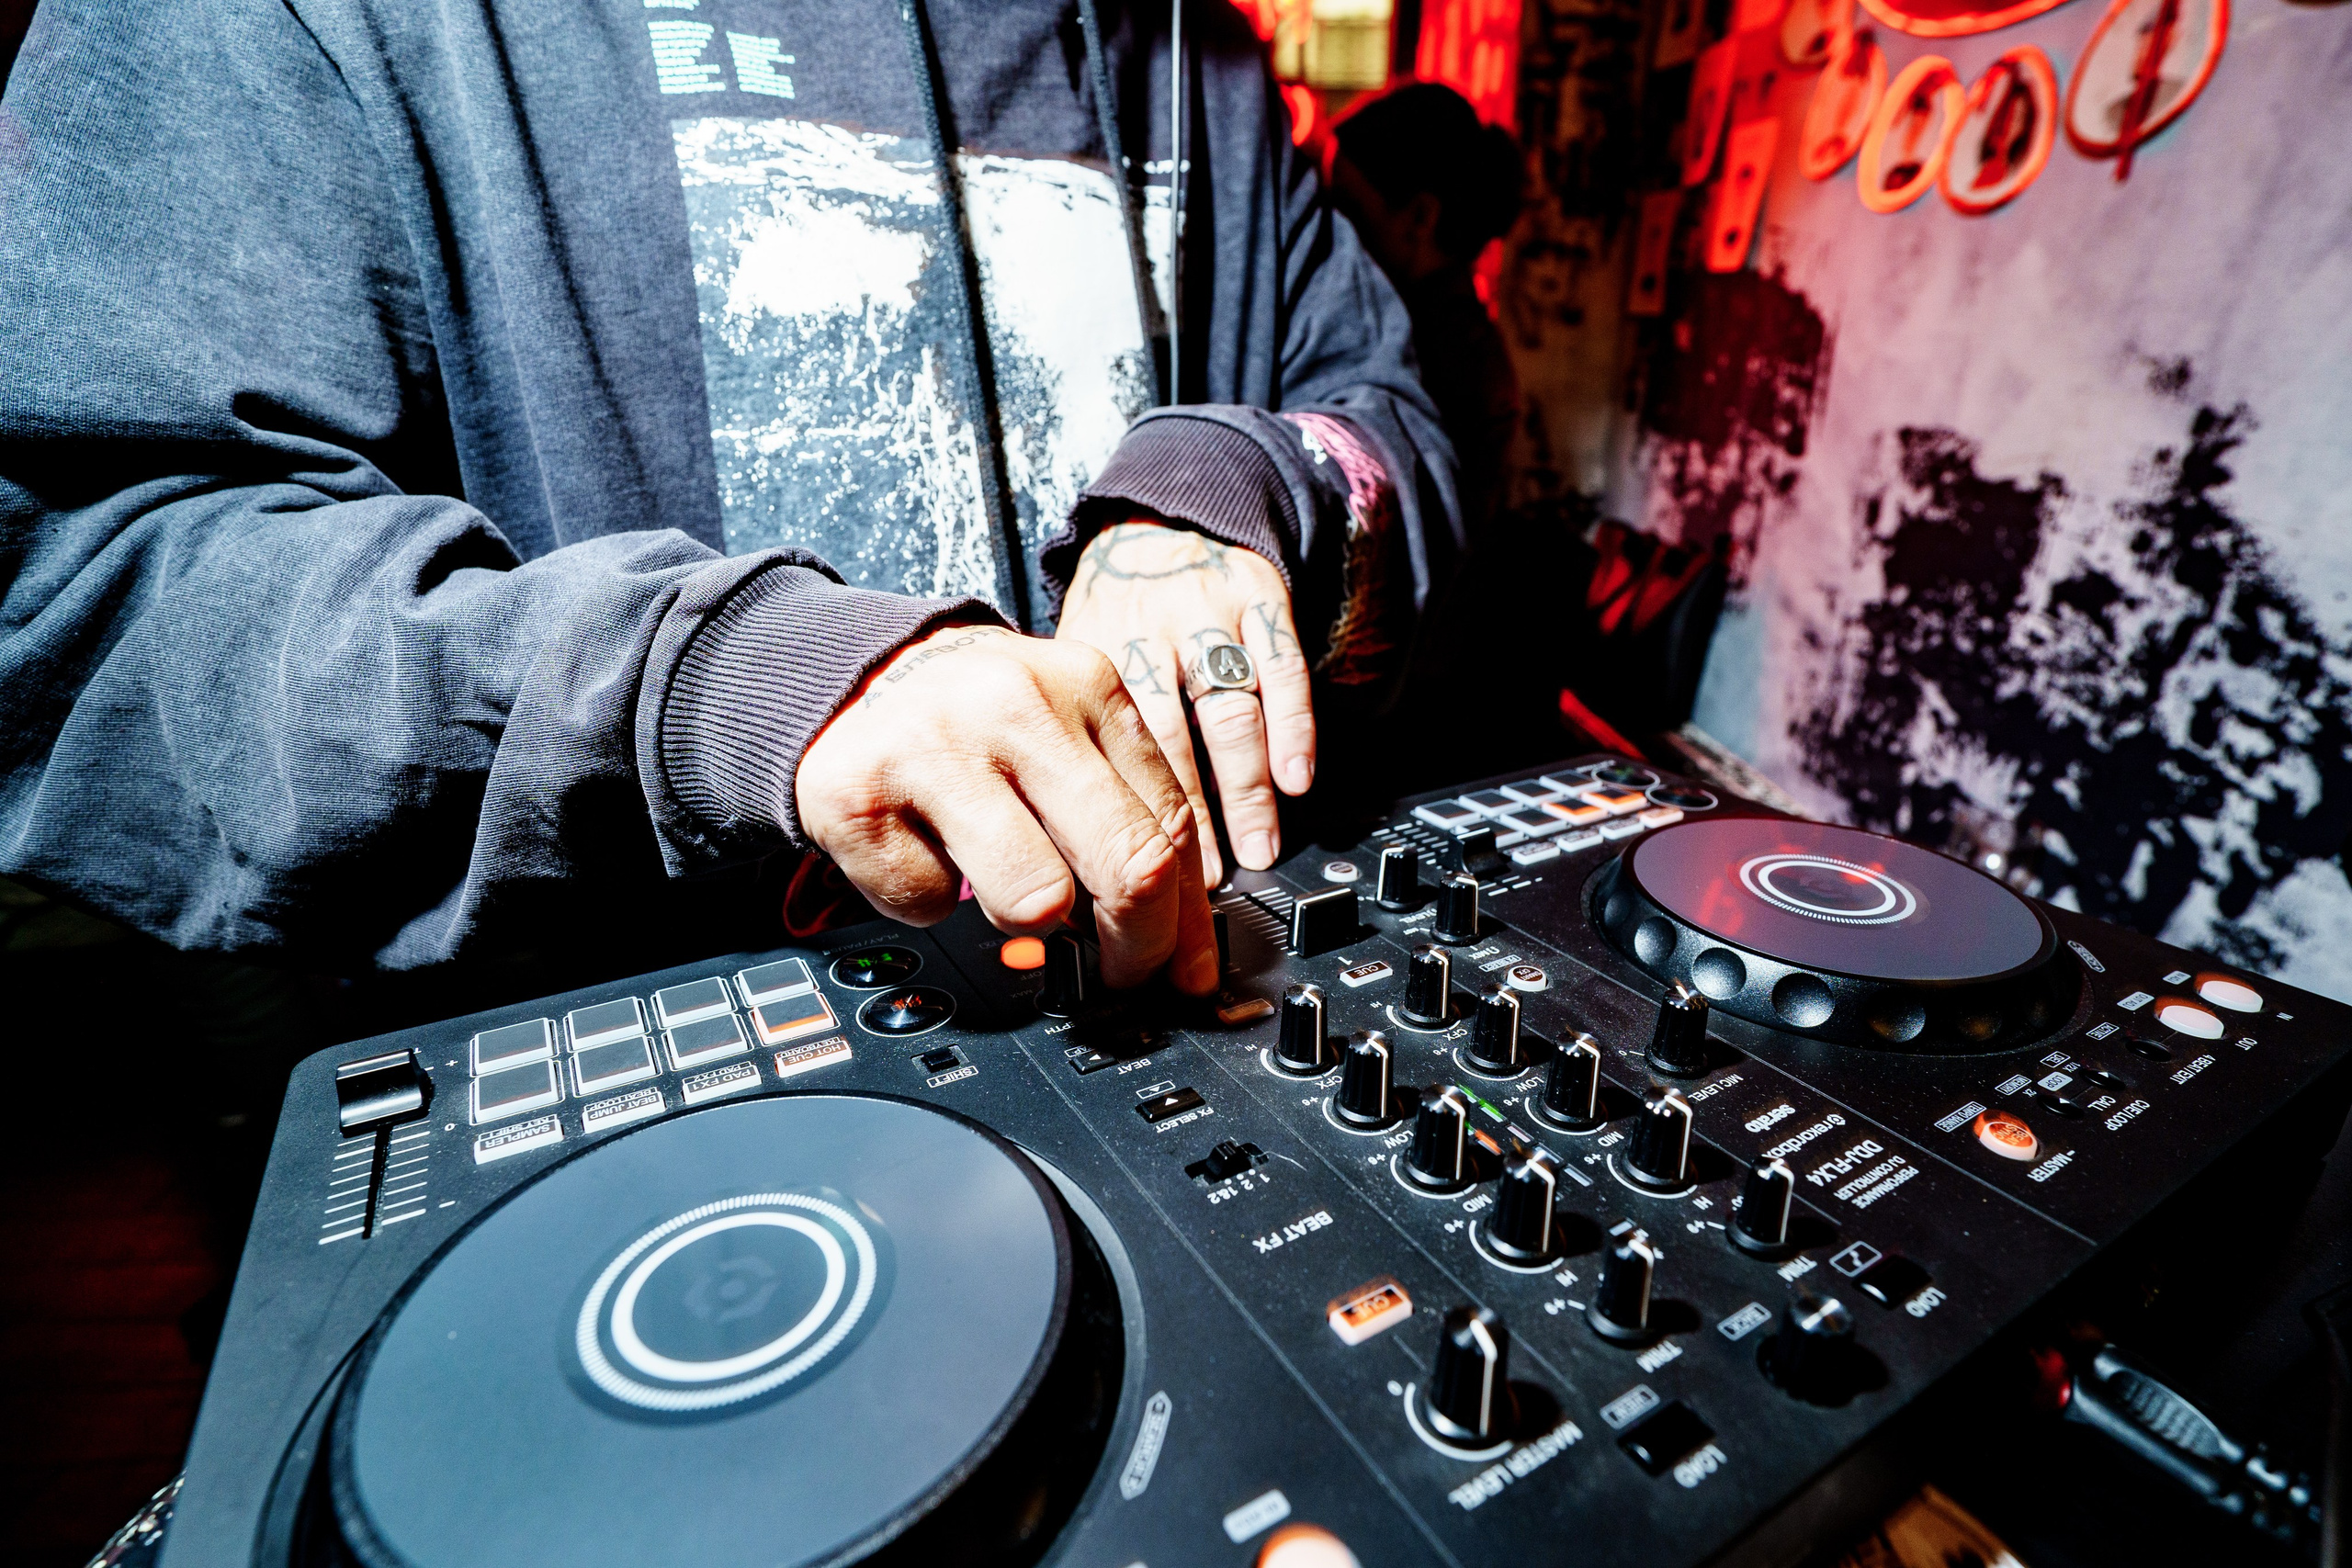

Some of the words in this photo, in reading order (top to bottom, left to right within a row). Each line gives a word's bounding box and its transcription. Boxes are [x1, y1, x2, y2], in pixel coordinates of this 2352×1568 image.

[1355, 964, 1379, 977] CUE
[2121, 999, 2136, 1008] ADJ
[2135, 994, 2147, 1003] OUT
[2277, 1011, 2294, 1021] IN
[1443, 1026, 1468, 1041] CFX
[2088, 1023, 2115, 1039] ACTIVE
[779, 1040, 836, 1058] KEYBOARD
[816, 1043, 841, 1055] HOT
[1245, 1043, 1257, 1052] HI
[2234, 1037, 2257, 1051] OUT
[788, 1053, 814, 1063] CUE
[2046, 1054, 2064, 1065] DEL
[2203, 1054, 2216, 1062] 4
[719, 1064, 741, 1074] PAD
[1116, 1058, 1151, 1074] BEAT
[2062, 1061, 2080, 1072] 1/2X
[2169, 1056, 2211, 1085] BEAT/EXIT
[723, 1068, 751, 1080] PAD
[931, 1068, 972, 1085] SHIFT
[1718, 1073, 1744, 1088] MIC
[2045, 1074, 2065, 1088] LOOP
[1315, 1075, 1343, 1089] CFX
[1516, 1076, 1544, 1091] LOW
[1998, 1077, 2028, 1094] MEMORY
[621, 1089, 651, 1101] BEAT
[1688, 1083, 1719, 1101] LEVEL
[2022, 1088, 2037, 1097] 2X
[590, 1097, 620, 1110] LOOP
[627, 1095, 657, 1109] BEAT
[1302, 1096, 1319, 1106] +6
[1503, 1095, 1519, 1106] +6
[2086, 1095, 2116, 1111] CALL
[589, 1104, 623, 1119] JUMP
[1196, 1106, 1215, 1118] FX
[1745, 1103, 1795, 1133] serato
[1958, 1103, 1982, 1119] TEMPO
[2104, 1099, 2150, 1131] CUE/LOOP
[525, 1117, 548, 1127] KEY
[1155, 1111, 1198, 1133] SELECT
[1938, 1111, 1962, 1130] RANGE
[485, 1123, 550, 1148] SAMPLER
[488, 1123, 524, 1137] SHIFT
[1992, 1123, 2017, 1140] SYNC
[2006, 1130, 2028, 1145] BEAT
[1383, 1130, 1414, 1147] LOW
[1597, 1130, 1623, 1147] MID
[1761, 1118, 1832, 1158] rekordbox
[1368, 1153, 1385, 1165] +6
[1583, 1152, 1600, 1164] +6
[1805, 1138, 1884, 1187] DDJ-FLX4
[1892, 1154, 1906, 1168] DJ
[2027, 1151, 2073, 1182] MASTER
[1833, 1160, 1896, 1201] CONTROLLER
[1850, 1165, 1919, 1210] PERFORMANCE
[1207, 1184, 1239, 1204] 1&2
[1461, 1193, 1493, 1213] MID
[1692, 1195, 1713, 1210] HI
[1283, 1210, 1333, 1241] BEAT
[1251, 1232, 1283, 1255] FX
[1905, 1287, 1947, 1317] LOAD
[1504, 1420, 1583, 1478] MASTER
[1447, 1463, 1513, 1510] LEVEL
